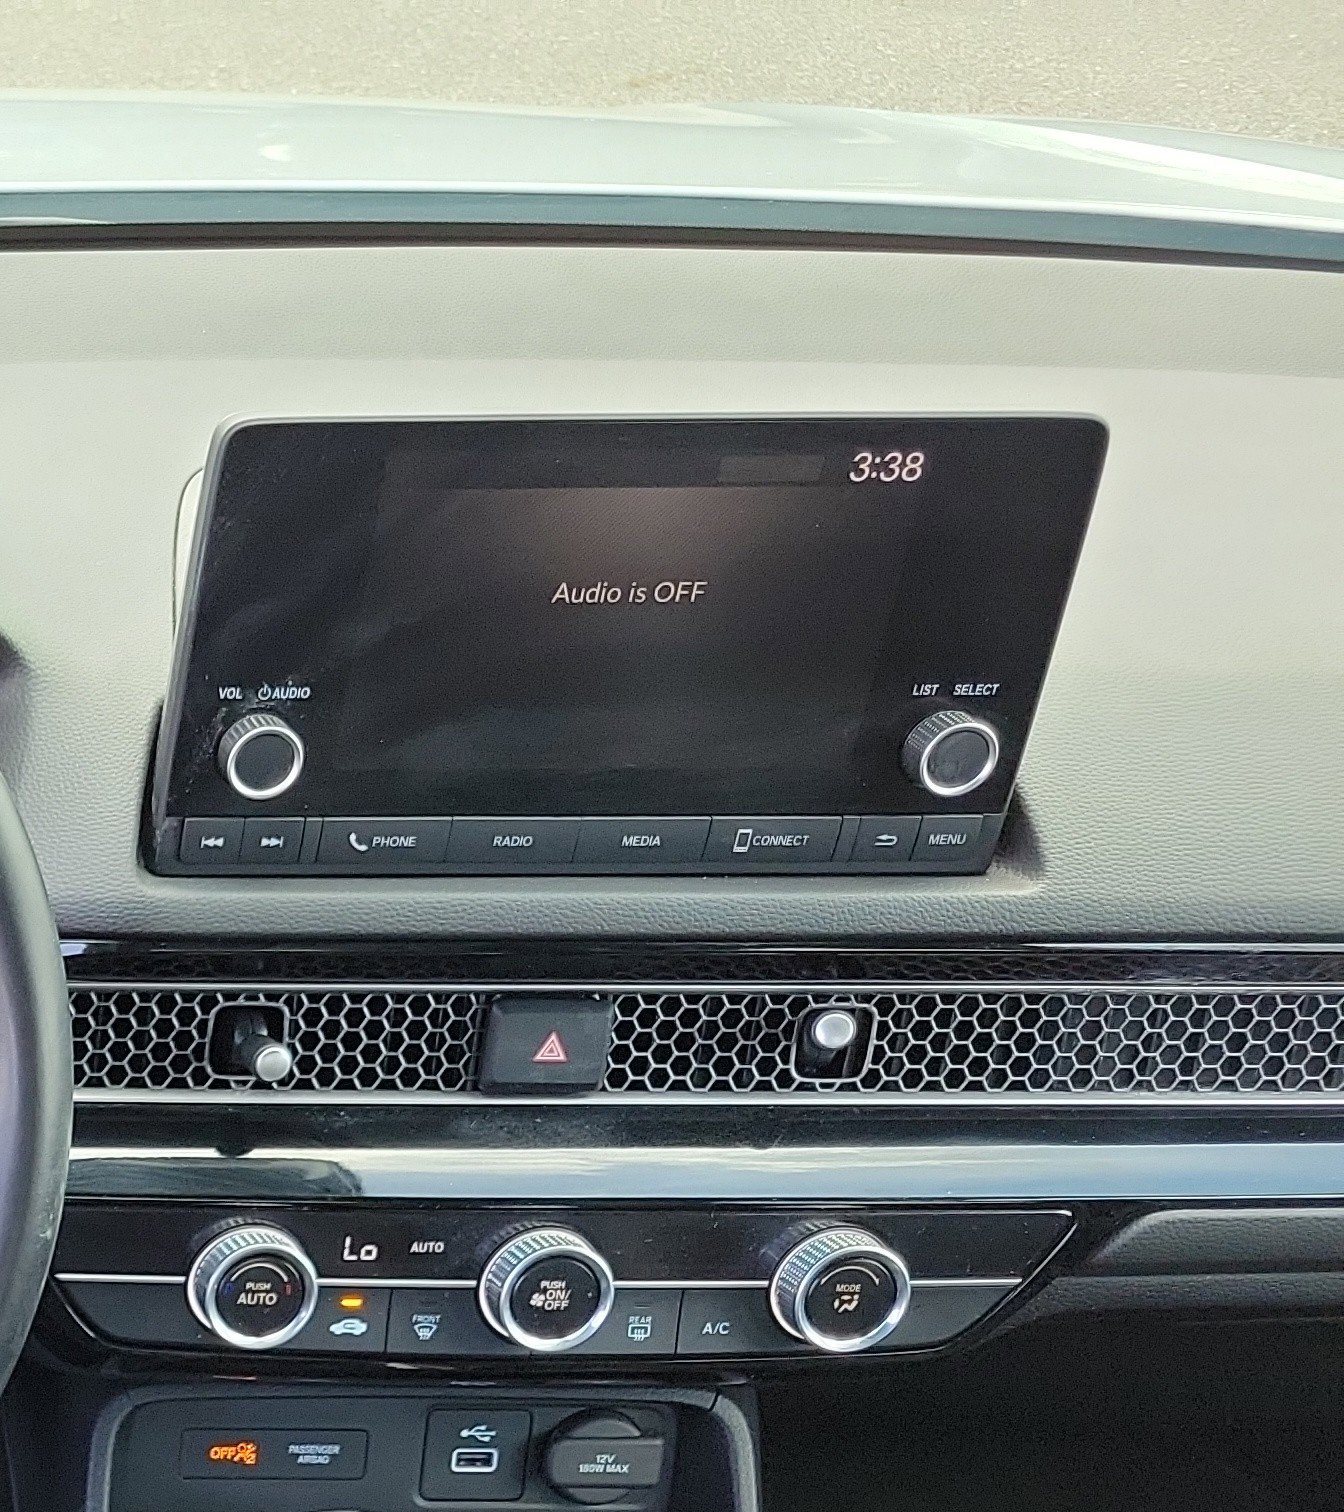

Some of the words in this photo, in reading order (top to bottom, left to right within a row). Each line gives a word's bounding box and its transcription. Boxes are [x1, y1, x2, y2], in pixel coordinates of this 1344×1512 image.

[848, 451, 925, 482] 3:38
[551, 582, 622, 604] Audio
[629, 582, 647, 603] is
[653, 581, 708, 603] OFF
[218, 686, 243, 700] VOL
[272, 685, 311, 700] AUDIO
[912, 684, 939, 696] LIST
[953, 684, 1000, 696] SELECT
[371, 835, 417, 848] PHONE
[493, 835, 534, 847] RADIO
[621, 835, 661, 847] MEDIA
[752, 834, 809, 847] CONNECT
[928, 833, 967, 846] MENU
[410, 1241, 444, 1254] AUTO
[245, 1282, 272, 1291] PUSH
[541, 1281, 566, 1289] PUSH
[835, 1283, 861, 1293] MODE
[236, 1292, 278, 1305] AUTO
[546, 1289, 571, 1300] ON/
[544, 1300, 570, 1310] OFF
[412, 1314, 441, 1323] FRONT
[629, 1316, 652, 1324] REAR
[702, 1322, 730, 1335] A/C
[210, 1446, 237, 1459] OFF
[288, 1444, 340, 1454] PASSENGER
[596, 1454, 616, 1464] 12V
[606, 1463, 630, 1473] MAX
